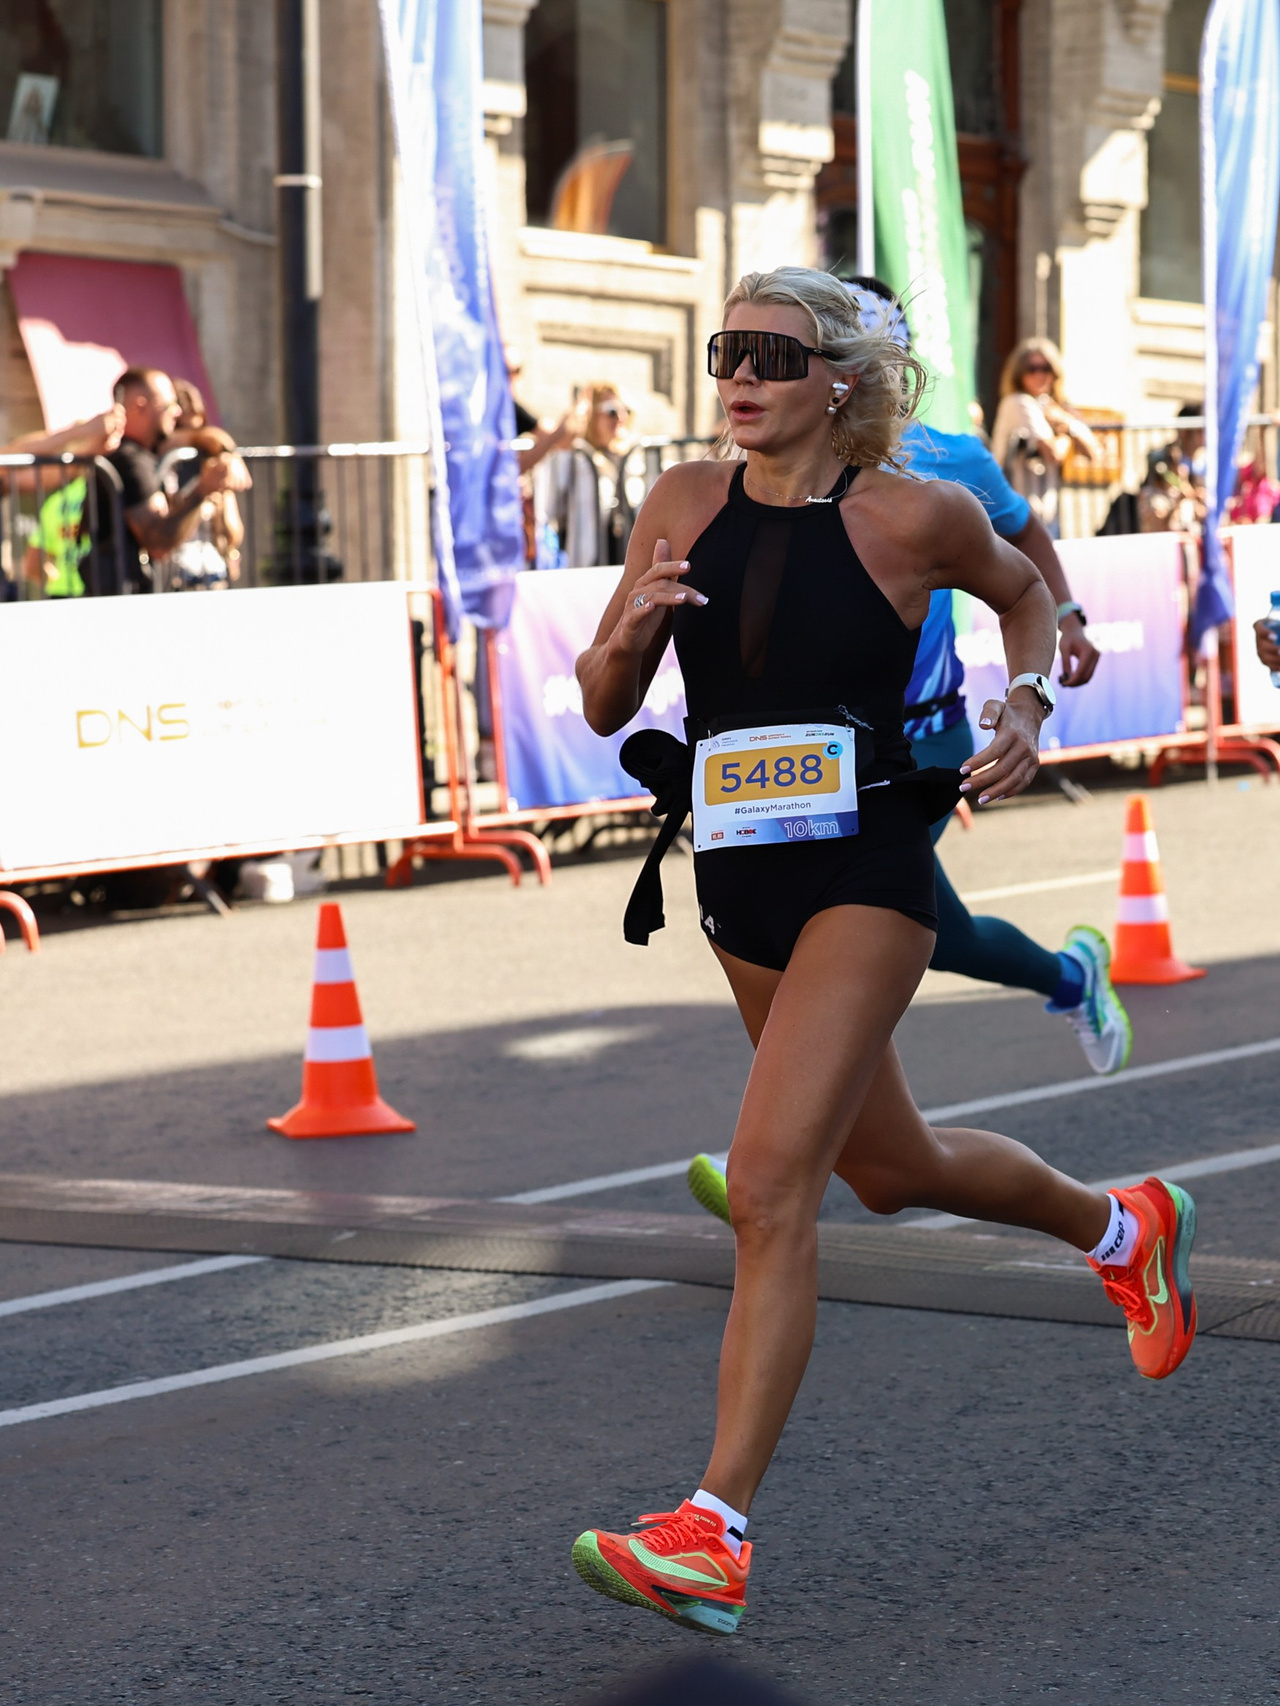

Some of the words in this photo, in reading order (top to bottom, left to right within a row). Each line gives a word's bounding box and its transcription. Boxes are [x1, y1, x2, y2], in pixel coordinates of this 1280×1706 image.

[76, 703, 190, 749] DNS
[720, 754, 824, 793] 5488
[734, 802, 812, 815] #GalaxyMarathon
[784, 819, 839, 838] 10km
